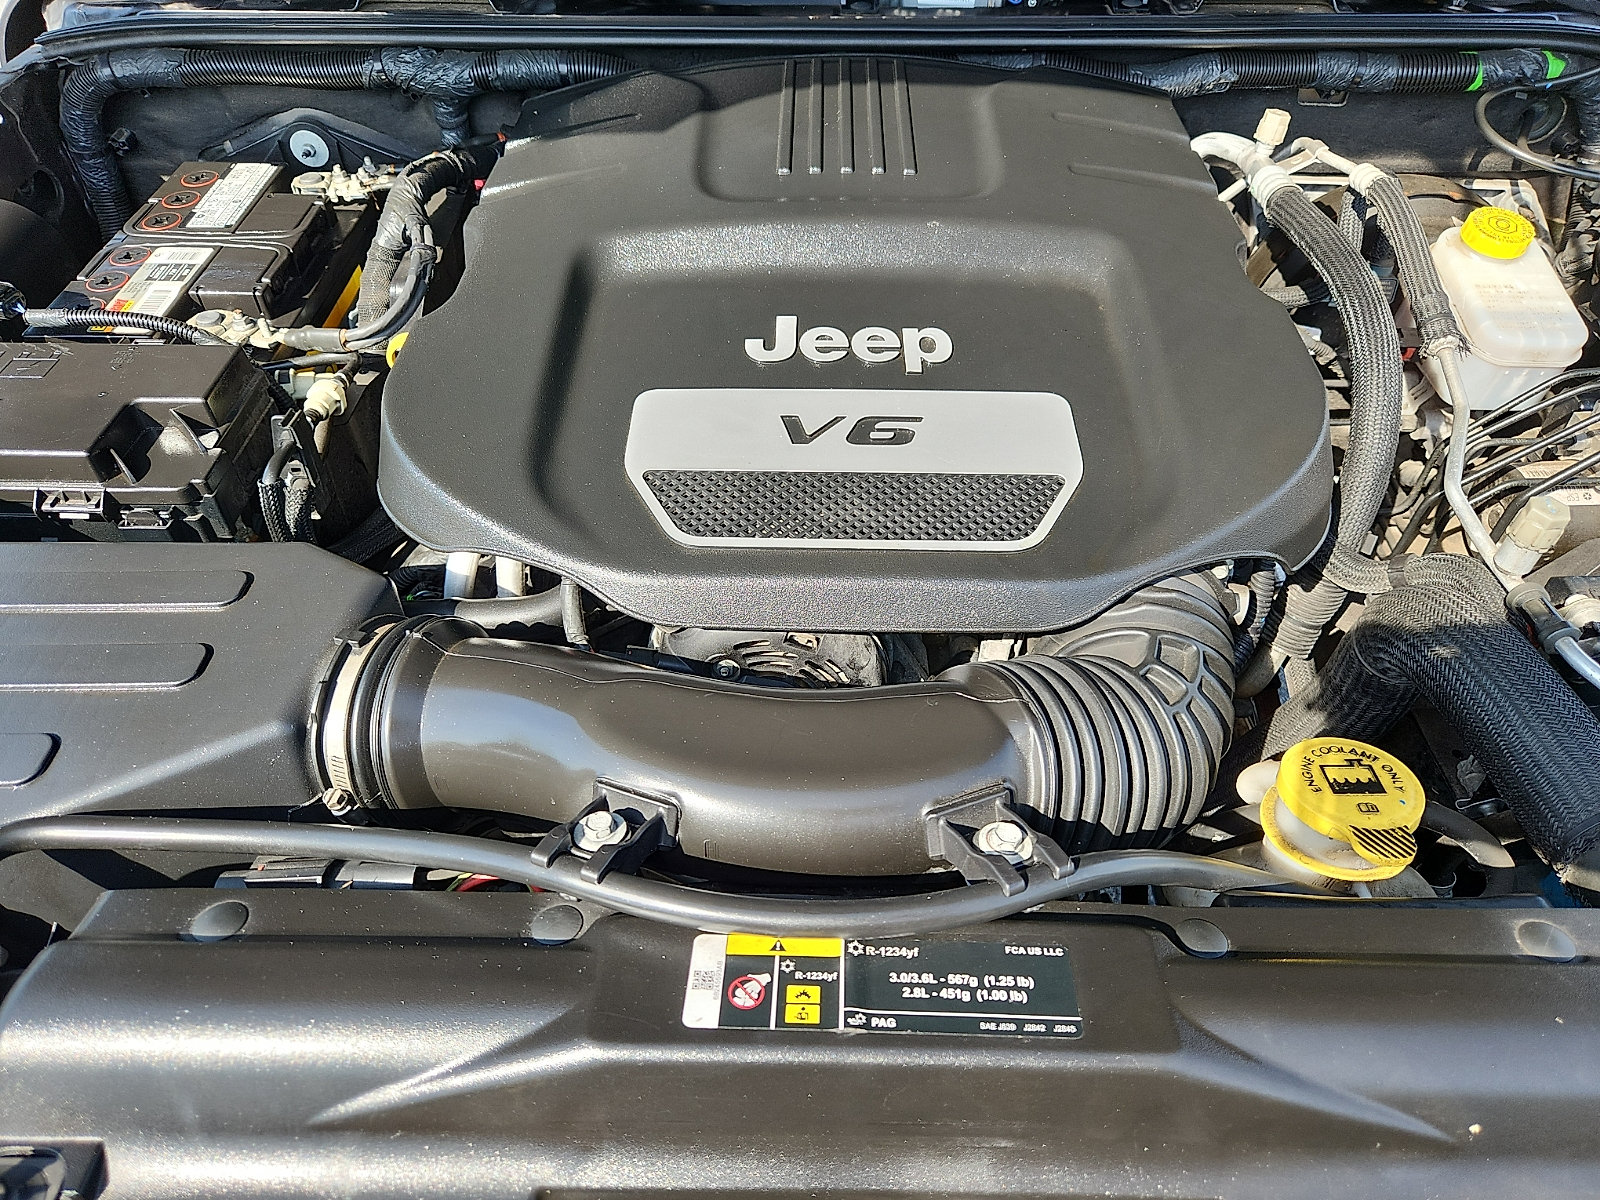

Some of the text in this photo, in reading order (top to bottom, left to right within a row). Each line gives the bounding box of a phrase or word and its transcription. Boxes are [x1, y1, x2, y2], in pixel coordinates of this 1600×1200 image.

[744, 315, 953, 375] Jeep
[780, 415, 924, 445] V6
[1301, 746, 1406, 793] ENGINE COOLANT ONLY
[865, 946, 920, 959] R-1234yf
[1004, 946, 1064, 957] FCA US LLC
[795, 971, 838, 982] R-1234yf
[889, 972, 938, 984] 3.0/3.6L
[947, 973, 979, 988] 567g
[984, 975, 1015, 988] (1.25
[1016, 976, 1035, 990] lb)
[902, 987, 930, 999] 2.8L
[939, 988, 971, 1003] 451g
[976, 989, 1008, 1003] (1.00
[1009, 990, 1028, 1004] lb)
[871, 1017, 897, 1028] PAG
